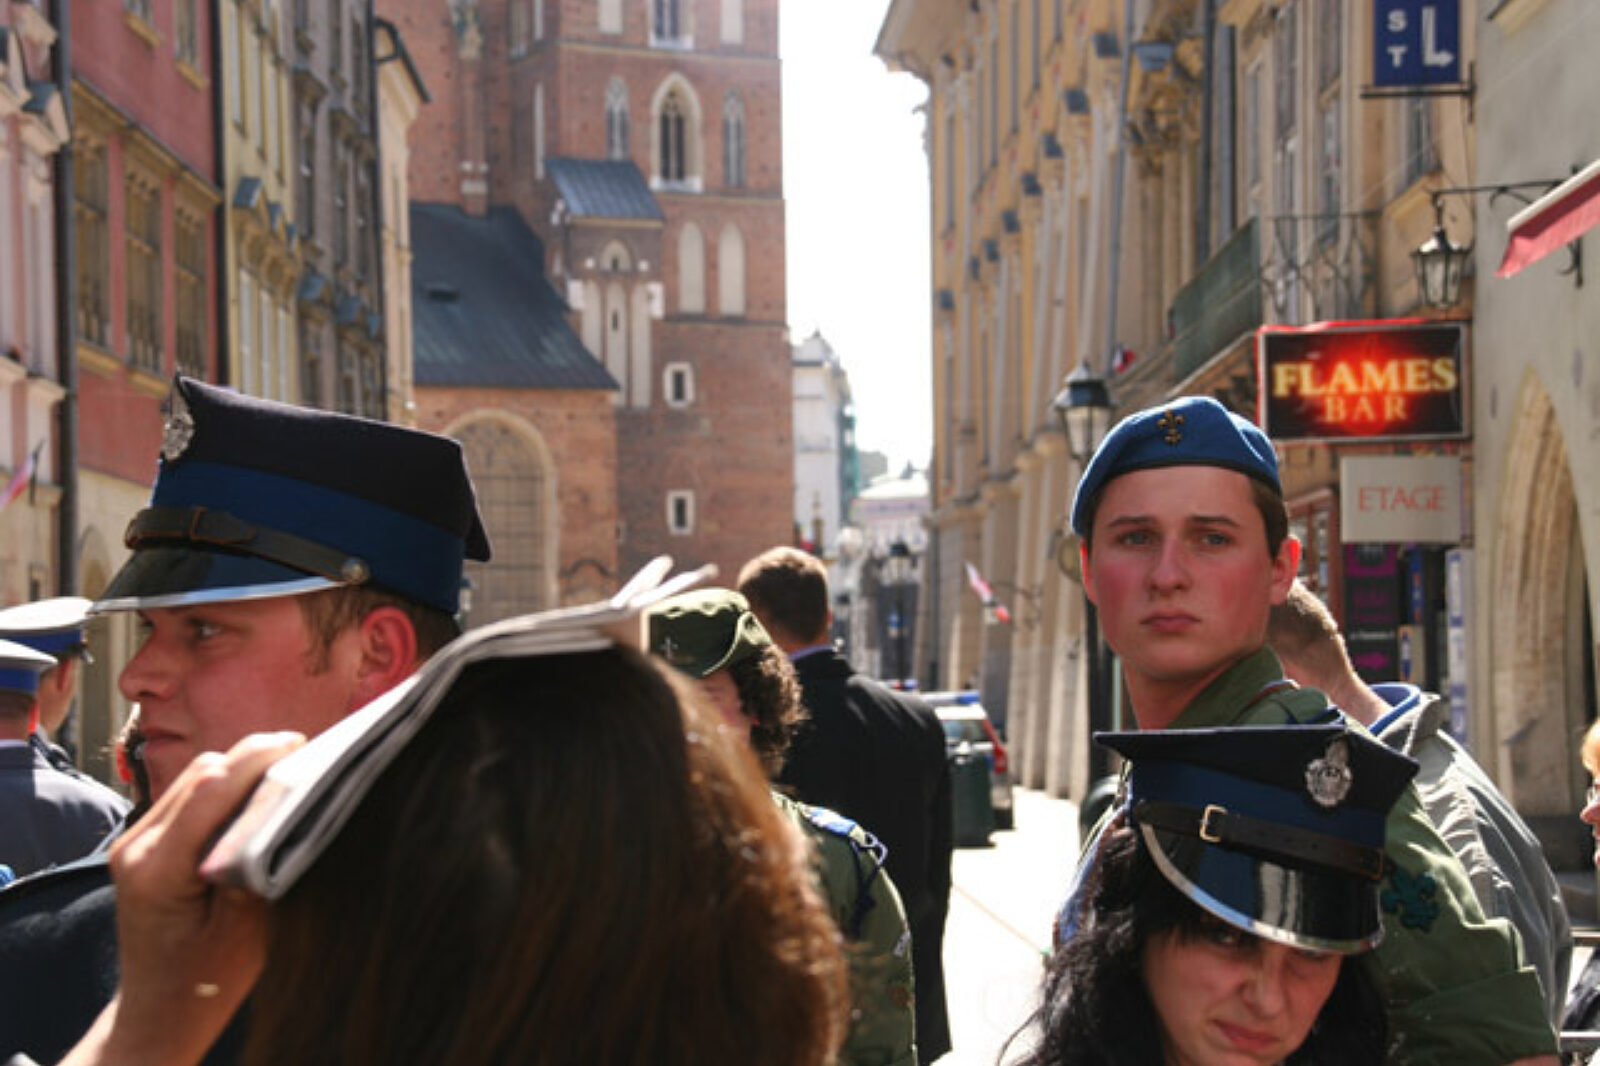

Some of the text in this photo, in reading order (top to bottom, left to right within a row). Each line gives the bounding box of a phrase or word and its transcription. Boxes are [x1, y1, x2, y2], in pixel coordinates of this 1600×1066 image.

[1272, 357, 1457, 397] FLAMES
[1324, 395, 1407, 423] BAR
[1359, 485, 1448, 511] ETAGE
